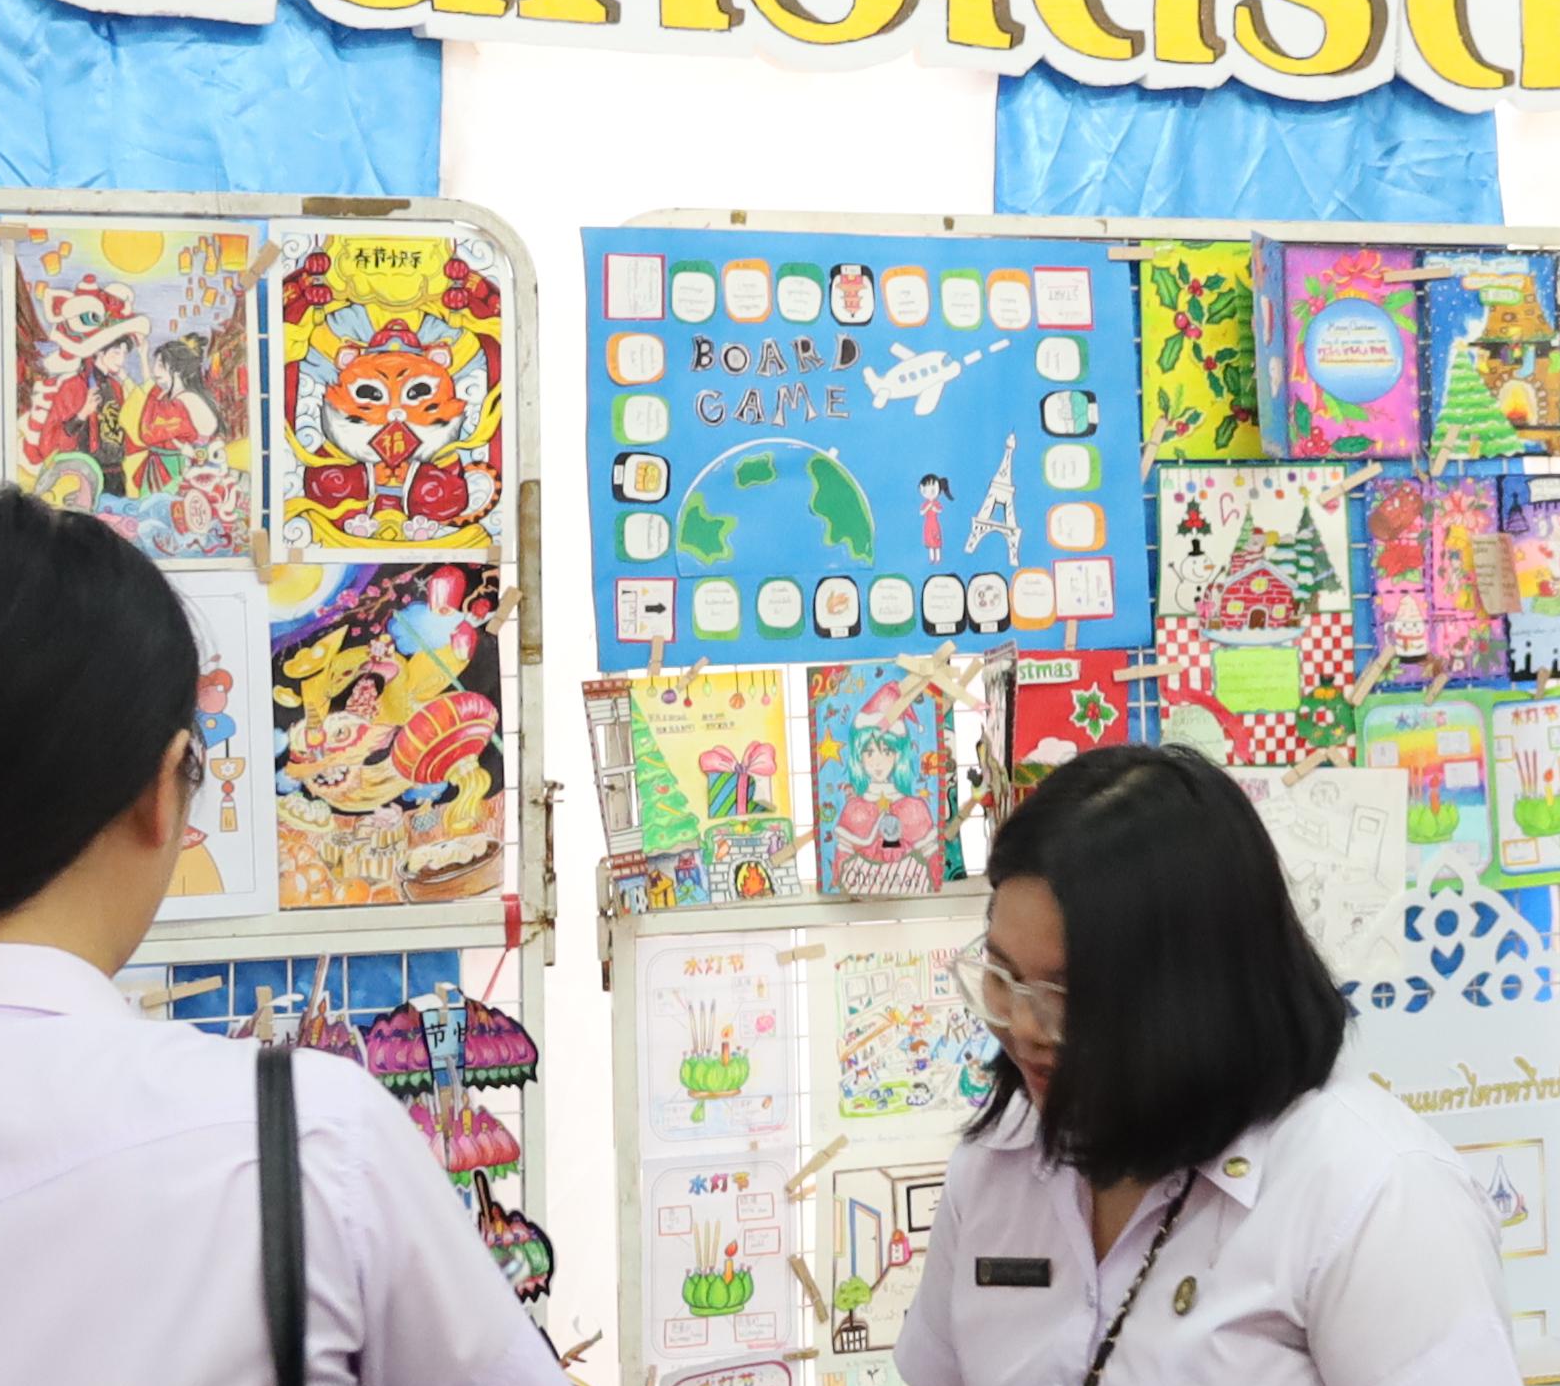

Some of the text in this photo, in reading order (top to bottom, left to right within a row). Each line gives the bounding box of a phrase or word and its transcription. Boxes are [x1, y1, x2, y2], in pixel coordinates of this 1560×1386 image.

[352, 246, 423, 271] 春节快乐
[690, 332, 863, 378] BOARD
[694, 380, 852, 428] GAME
[1018, 659, 1074, 681] stmas
[688, 1170, 751, 1196] 水灯节
